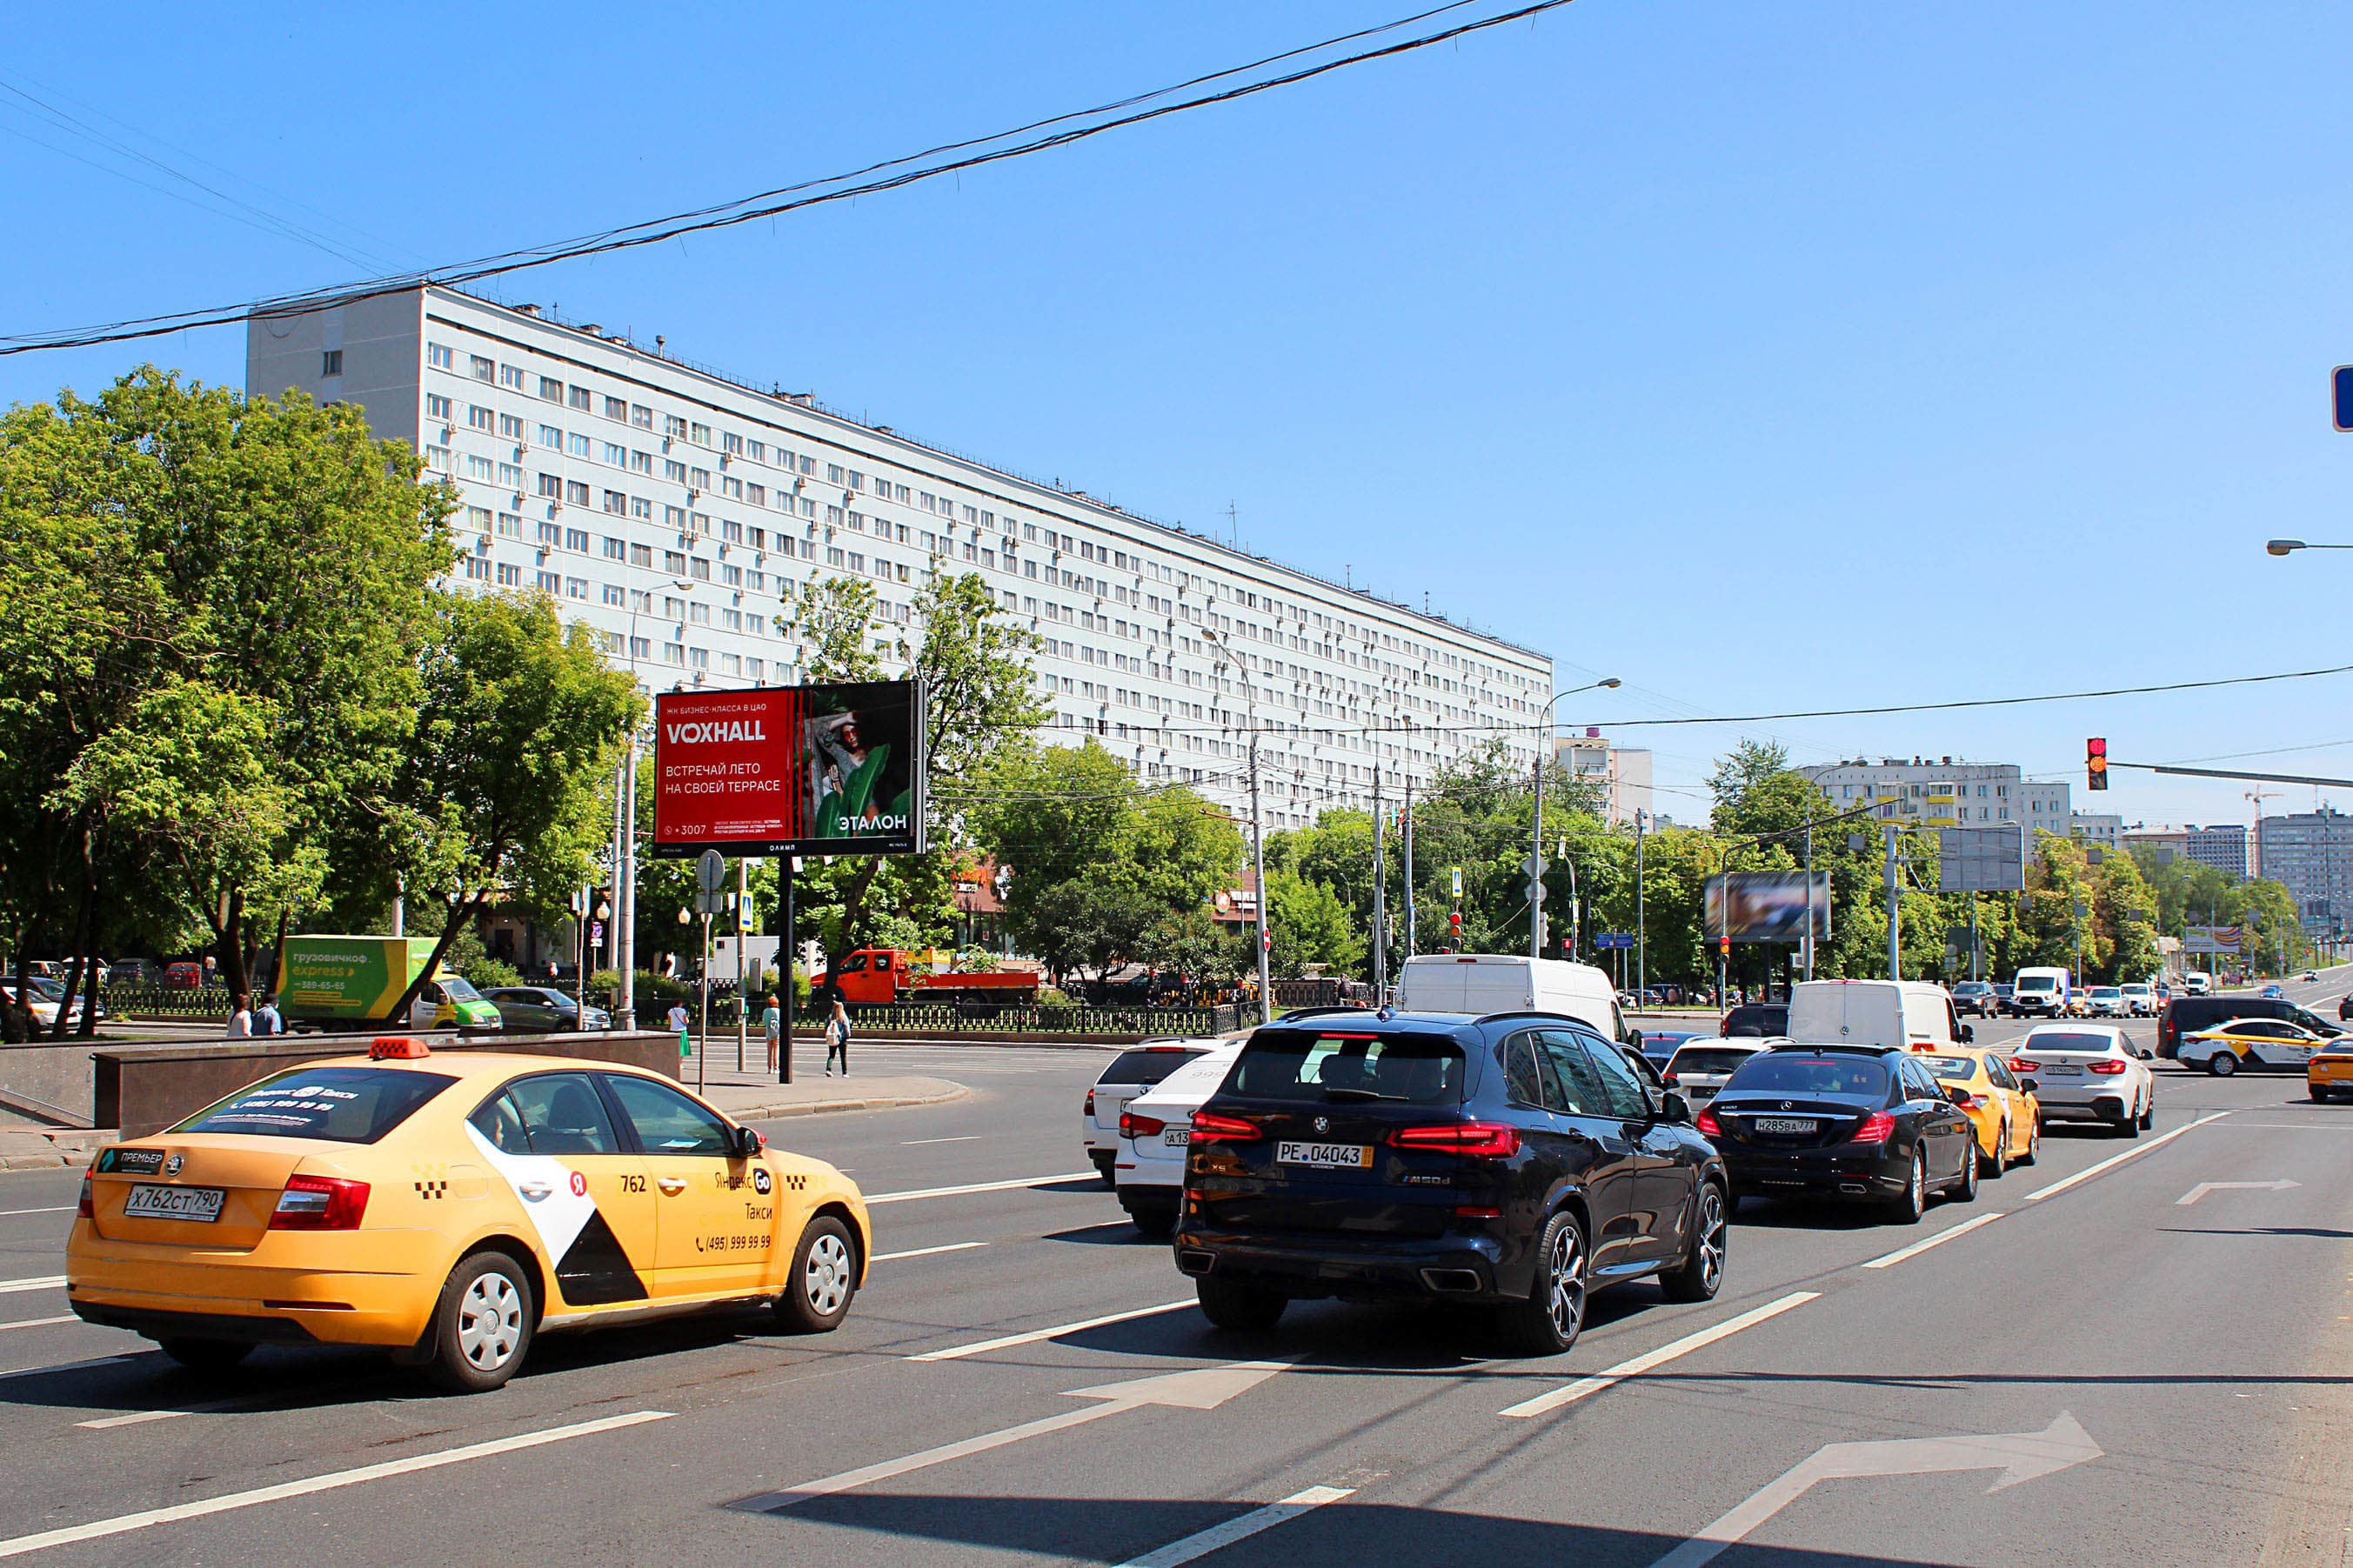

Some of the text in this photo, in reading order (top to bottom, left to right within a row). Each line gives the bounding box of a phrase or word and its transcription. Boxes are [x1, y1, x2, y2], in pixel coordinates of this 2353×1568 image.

[750, 704, 766, 712] ЦАО
[666, 720, 766, 744] VOXHALL
[666, 762, 761, 777] ВСТРЕЧАЙ ЛЕТО
[665, 780, 780, 794] НА СВОЕЙ ТЕРРАСЕ
[839, 815, 907, 831] ЭТАЛОН
[292, 966, 344, 978] express
[1168, 1131, 1189, 1144] А13
[121, 1152, 163, 1164] ПРЕМЬЕР
[1281, 1144, 1360, 1164] PE 04043
[573, 1174, 584, 1194] Я
[620, 1175, 646, 1193] 762
[714, 1171, 771, 1191] Яндекс Go
[745, 1203, 772, 1219] Такси
[705, 1235, 771, 1252] (495) 999 99 99
